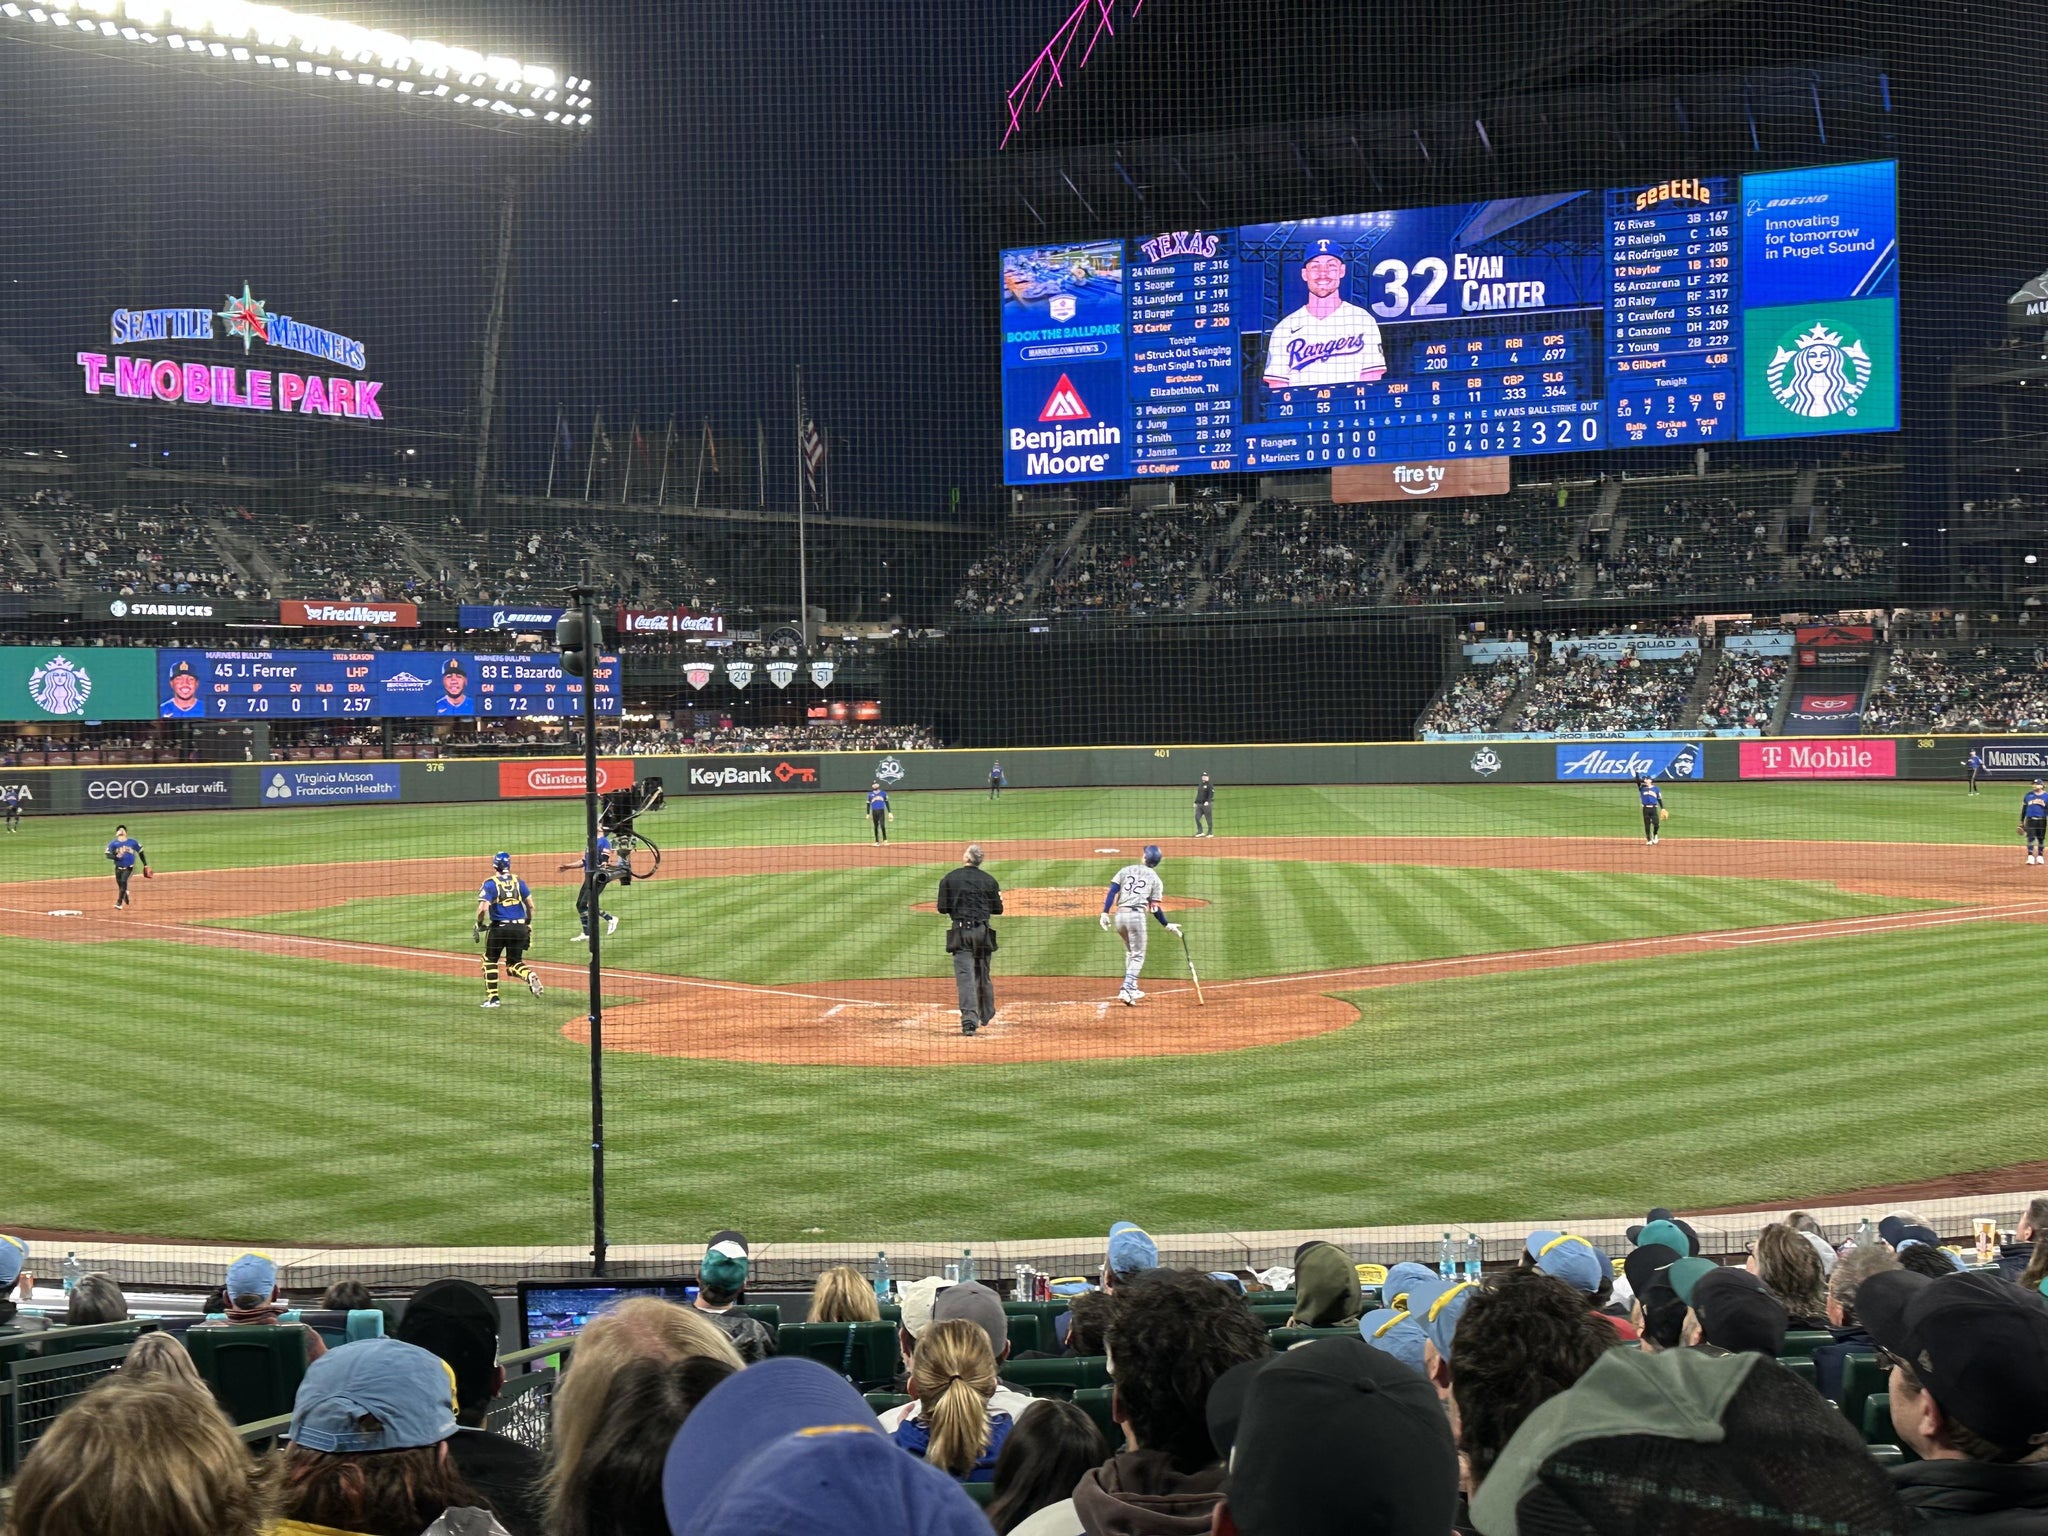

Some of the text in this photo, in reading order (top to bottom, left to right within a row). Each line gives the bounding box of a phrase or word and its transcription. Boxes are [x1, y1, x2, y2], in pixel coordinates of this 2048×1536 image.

[1636, 178, 1710, 211] seattle
[1766, 194, 1828, 206] BOEING
[1614, 211, 1728, 230] 76 Rivas 3B .167
[1765, 215, 1839, 230] Innovating
[1614, 226, 1728, 246] 29 Raleigh C .165
[1765, 229, 1859, 244] for tomorrow
[1141, 230, 1219, 263] TEXAS
[1614, 253, 1626, 262] 44
[1687, 245, 1701, 254] CF
[1706, 242, 1728, 252] .205
[1765, 240, 1875, 260] in Puget Sound
[1132, 261, 1229, 276] 24 Nimmo RF .316
[1614, 258, 1728, 276] 12 Naylor 1B .130
[1134, 275, 1229, 291] 5 Seager SS .212
[1371, 253, 1503, 317] 32 EVAN
[1614, 273, 1728, 292] 56 Arozarena LF .292
[1144, 293, 1183, 305] Langford
[1195, 292, 1205, 300] LF
[1210, 289, 1228, 299] .191
[1461, 280, 1545, 312] CARTER
[1614, 289, 1728, 308] 20 Raley RF .317
[1133, 311, 1142, 319] 21
[1195, 306, 1206, 314] 1B
[1210, 304, 1229, 313] .256
[1617, 305, 1728, 322] 3 Crawford SS .162
[1007, 324, 1120, 342] BOOK THE BALLPARK
[1145, 324, 1171, 333] Carter
[1195, 320, 1206, 329] CF
[1210, 318, 1230, 327] .200
[1628, 326, 1671, 337] Canzone
[1687, 322, 1702, 332] DH
[1706, 320, 1728, 331] .209
[112, 309, 366, 370] SEATTLE MARINERS
[1426, 335, 1564, 355] AVG HR RBI OPS
[1617, 336, 1728, 354] 2 Young 2B .229
[1146, 346, 1231, 360] Struck Out Swinging
[1287, 333, 1365, 369] Rangers
[1424, 348, 1565, 370] .200 2 4 .697
[1168, 361, 1194, 372] Single
[1196, 360, 1206, 368] To
[1208, 358, 1231, 367] Third
[1618, 362, 1630, 370] 36
[1632, 359, 1666, 370] Gilbert
[78, 352, 384, 420] T-MOBILE PARK
[1206, 384, 1218, 393] TN
[1528, 402, 1598, 415] BALL STRIKE OUT
[1010, 422, 1120, 452] Benjamin
[1531, 418, 1597, 444] 3 2 0
[1261, 437, 1297, 448] Rangers
[1261, 452, 1299, 463] Mariners
[1393, 465, 1445, 482] fire tv
[131, 604, 213, 616] STARBUCKS
[215, 664, 368, 677] 45 J. Ferrer LHP
[482, 666, 562, 679] 83 E. Bazardo
[734, 671, 747, 682] 24
[777, 671, 787, 682] 11
[817, 671, 828, 681] 51
[343, 698, 371, 711] 2.57
[1790, 712, 1860, 720] TOYOTA
[1476, 753, 1495, 765] 50
[1563, 750, 1655, 775] Alaska
[1789, 746, 1872, 769] Mobile
[426, 764, 444, 772] 376
[882, 762, 898, 772] 50
[295, 771, 373, 786] Virginia Mason
[691, 767, 771, 786] KeyBank
[88, 780, 227, 799] eero All-star wifi.
[295, 782, 393, 797] Franciscan Health
[1124, 876, 1146, 894] 32
